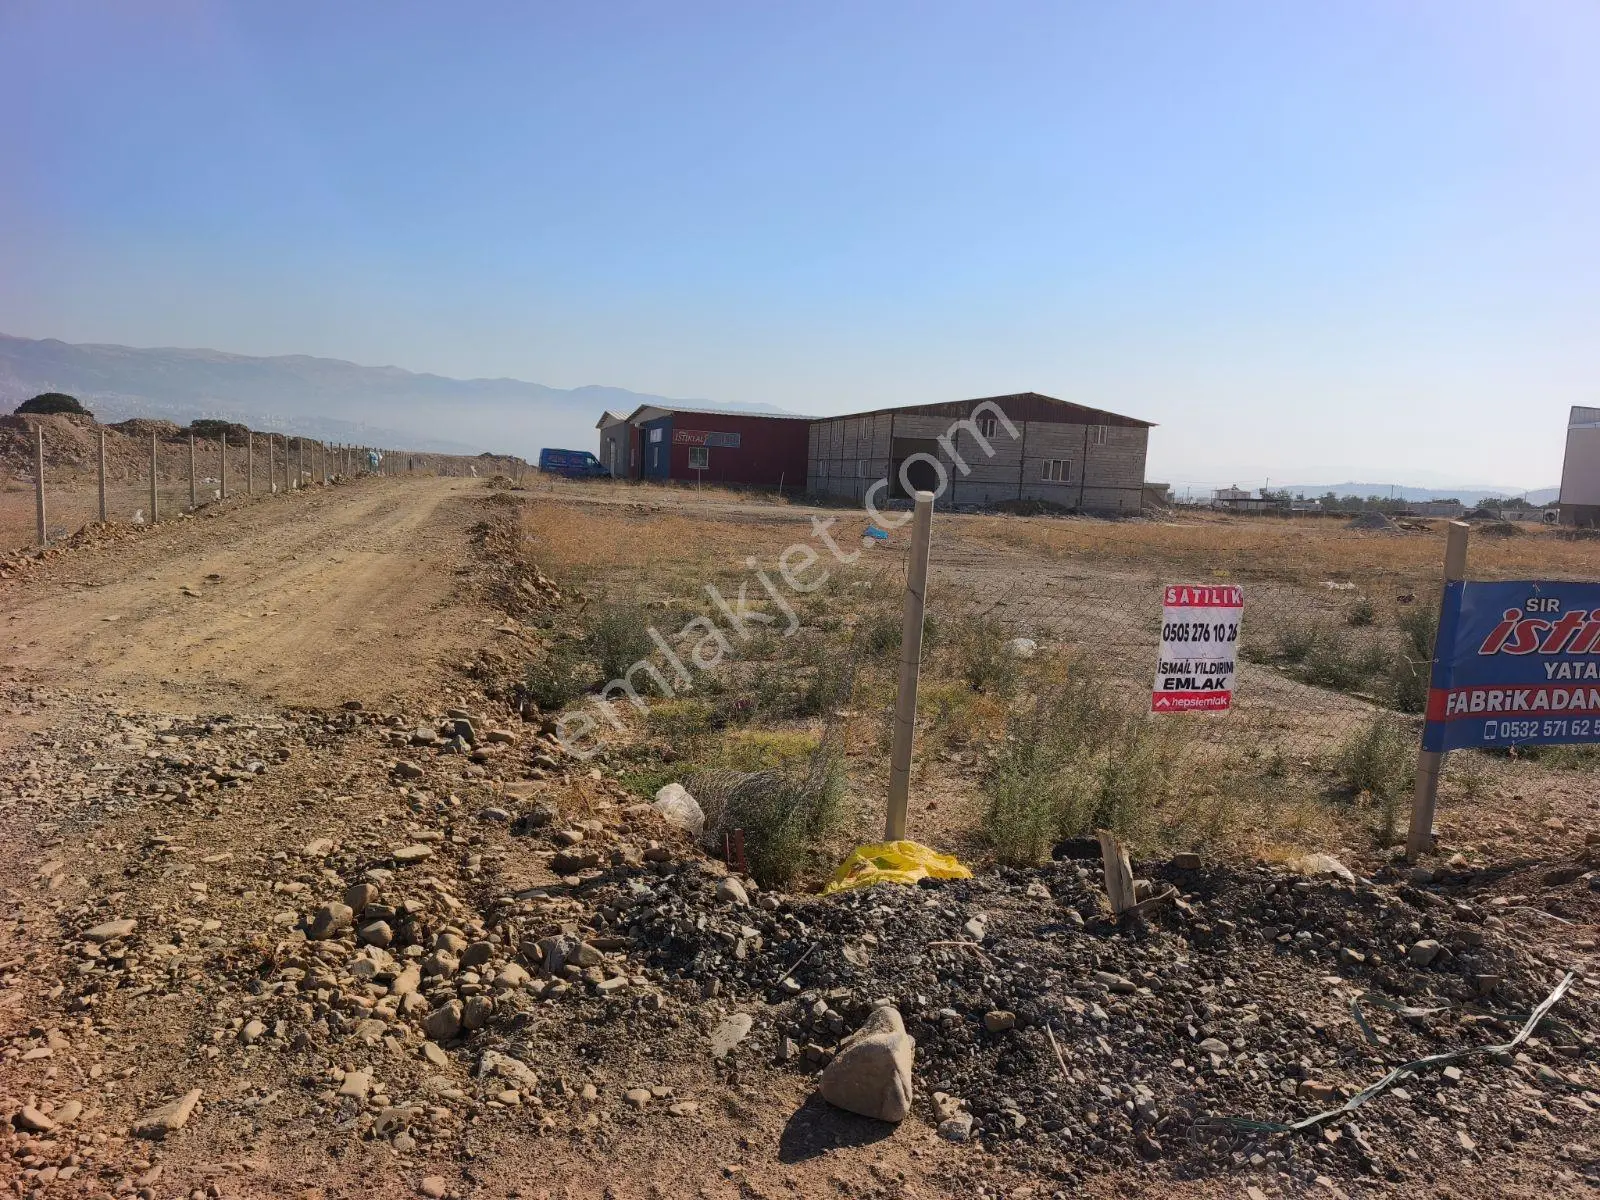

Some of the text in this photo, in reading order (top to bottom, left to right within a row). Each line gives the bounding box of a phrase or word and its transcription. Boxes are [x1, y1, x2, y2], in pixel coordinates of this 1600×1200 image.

[1166, 588, 1242, 604] SATILIK
[1526, 598, 1560, 613] SIR
[1163, 623, 1238, 642] 0505 276 10 26
[1478, 607, 1600, 656] isti
[1194, 661, 1234, 675] YILDIRIM
[1163, 678, 1225, 690] EMLAK
[1172, 696, 1228, 708] hepsiemlak
[1500, 721, 1538, 738] 0532
[1543, 720, 1567, 737] 571
[1571, 720, 1589, 736] 62
